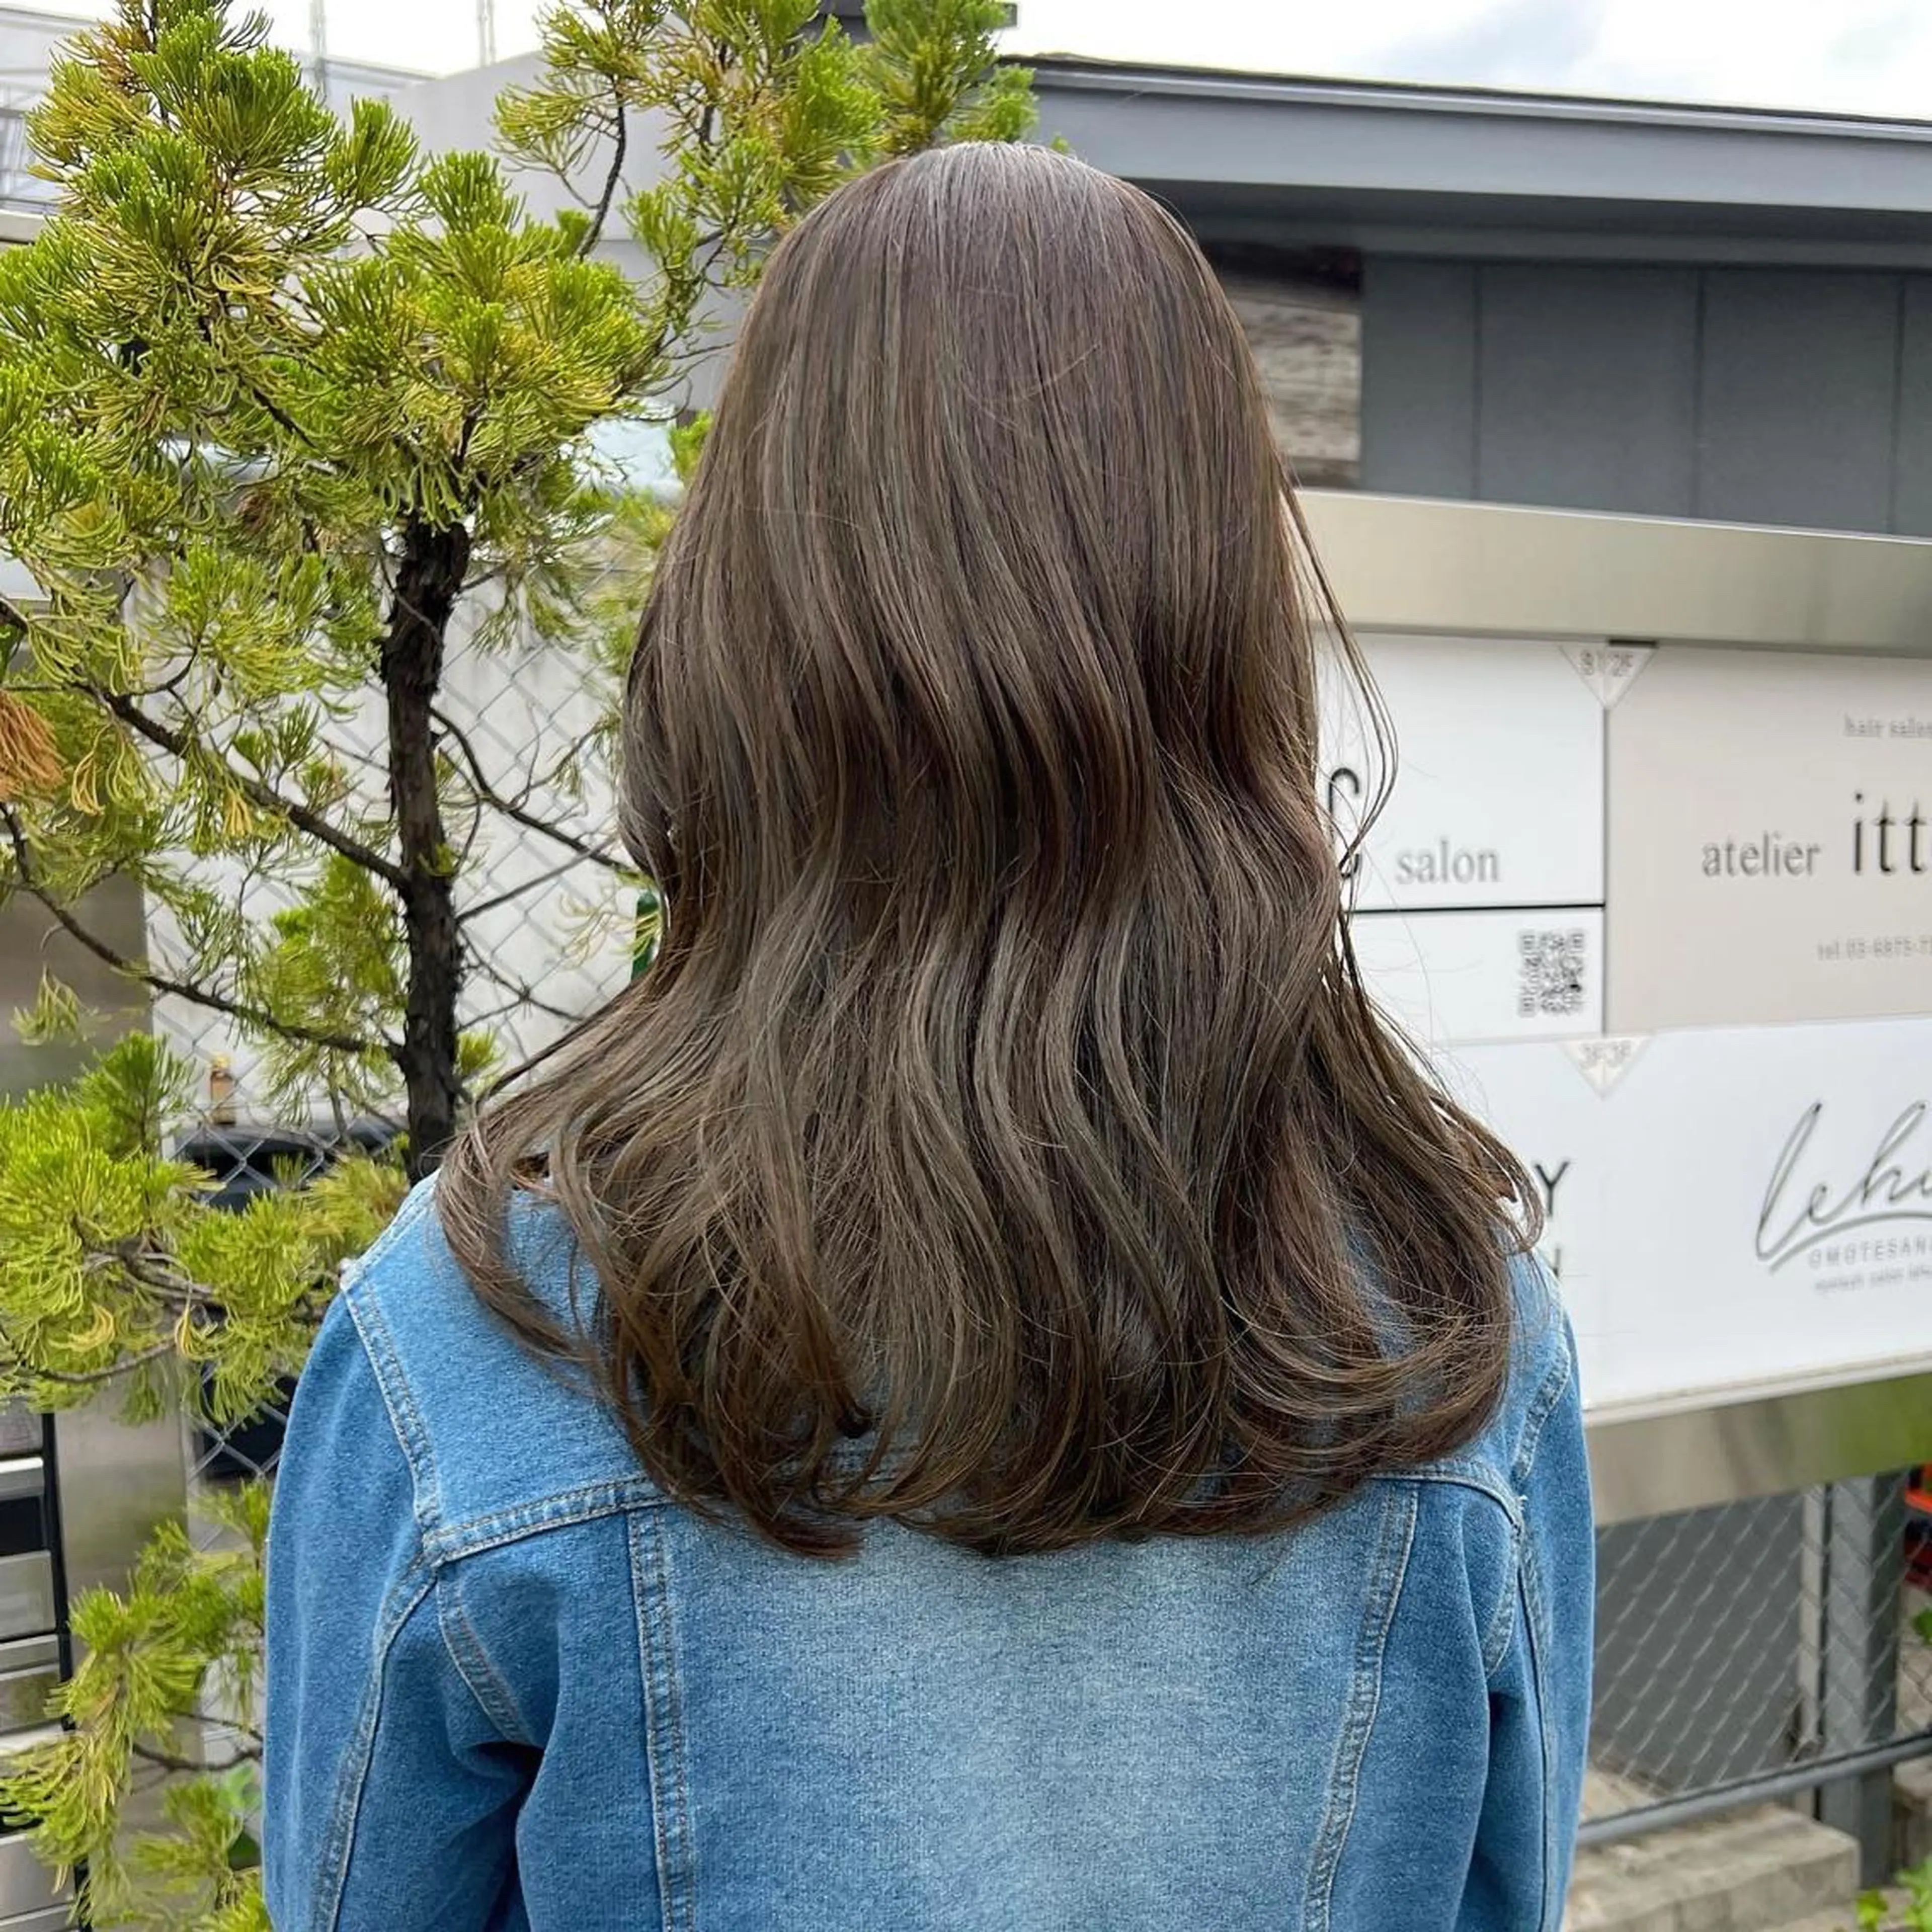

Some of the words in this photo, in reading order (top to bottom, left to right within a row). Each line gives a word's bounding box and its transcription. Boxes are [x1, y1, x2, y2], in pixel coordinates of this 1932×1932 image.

[1702, 830, 1821, 877] atelier
[1854, 792, 1928, 876] itt
[1396, 837, 1501, 884] salon
[1810, 1235, 1932, 1269] OMOTESAN
